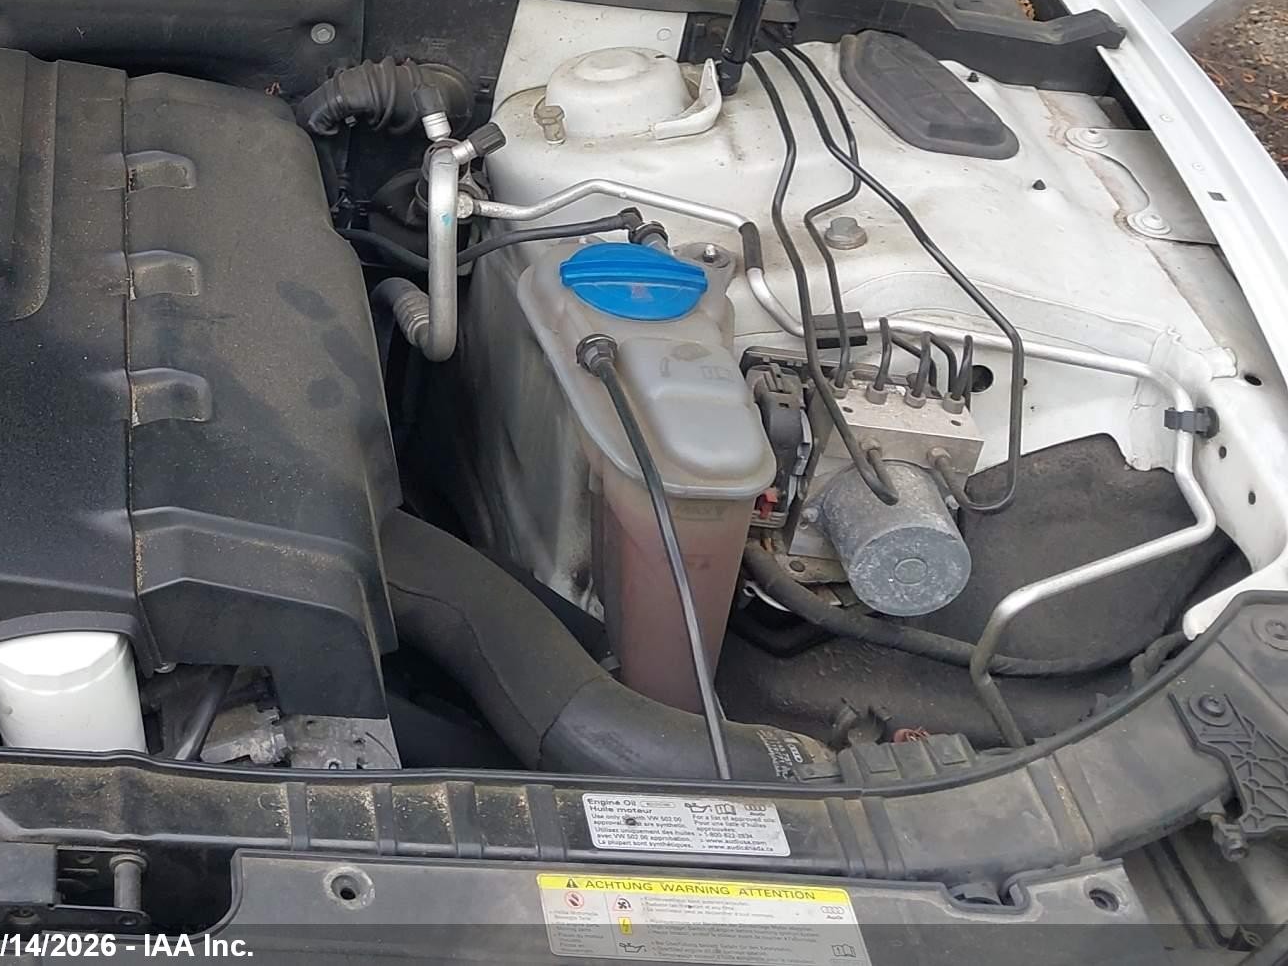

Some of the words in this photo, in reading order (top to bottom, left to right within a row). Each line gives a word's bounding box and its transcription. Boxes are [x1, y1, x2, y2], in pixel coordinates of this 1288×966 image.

[587, 799, 620, 807] Engine
[585, 880, 653, 892] ACHTUNG
[661, 884, 730, 896] WARNING
[738, 888, 816, 900] ATTENTION
